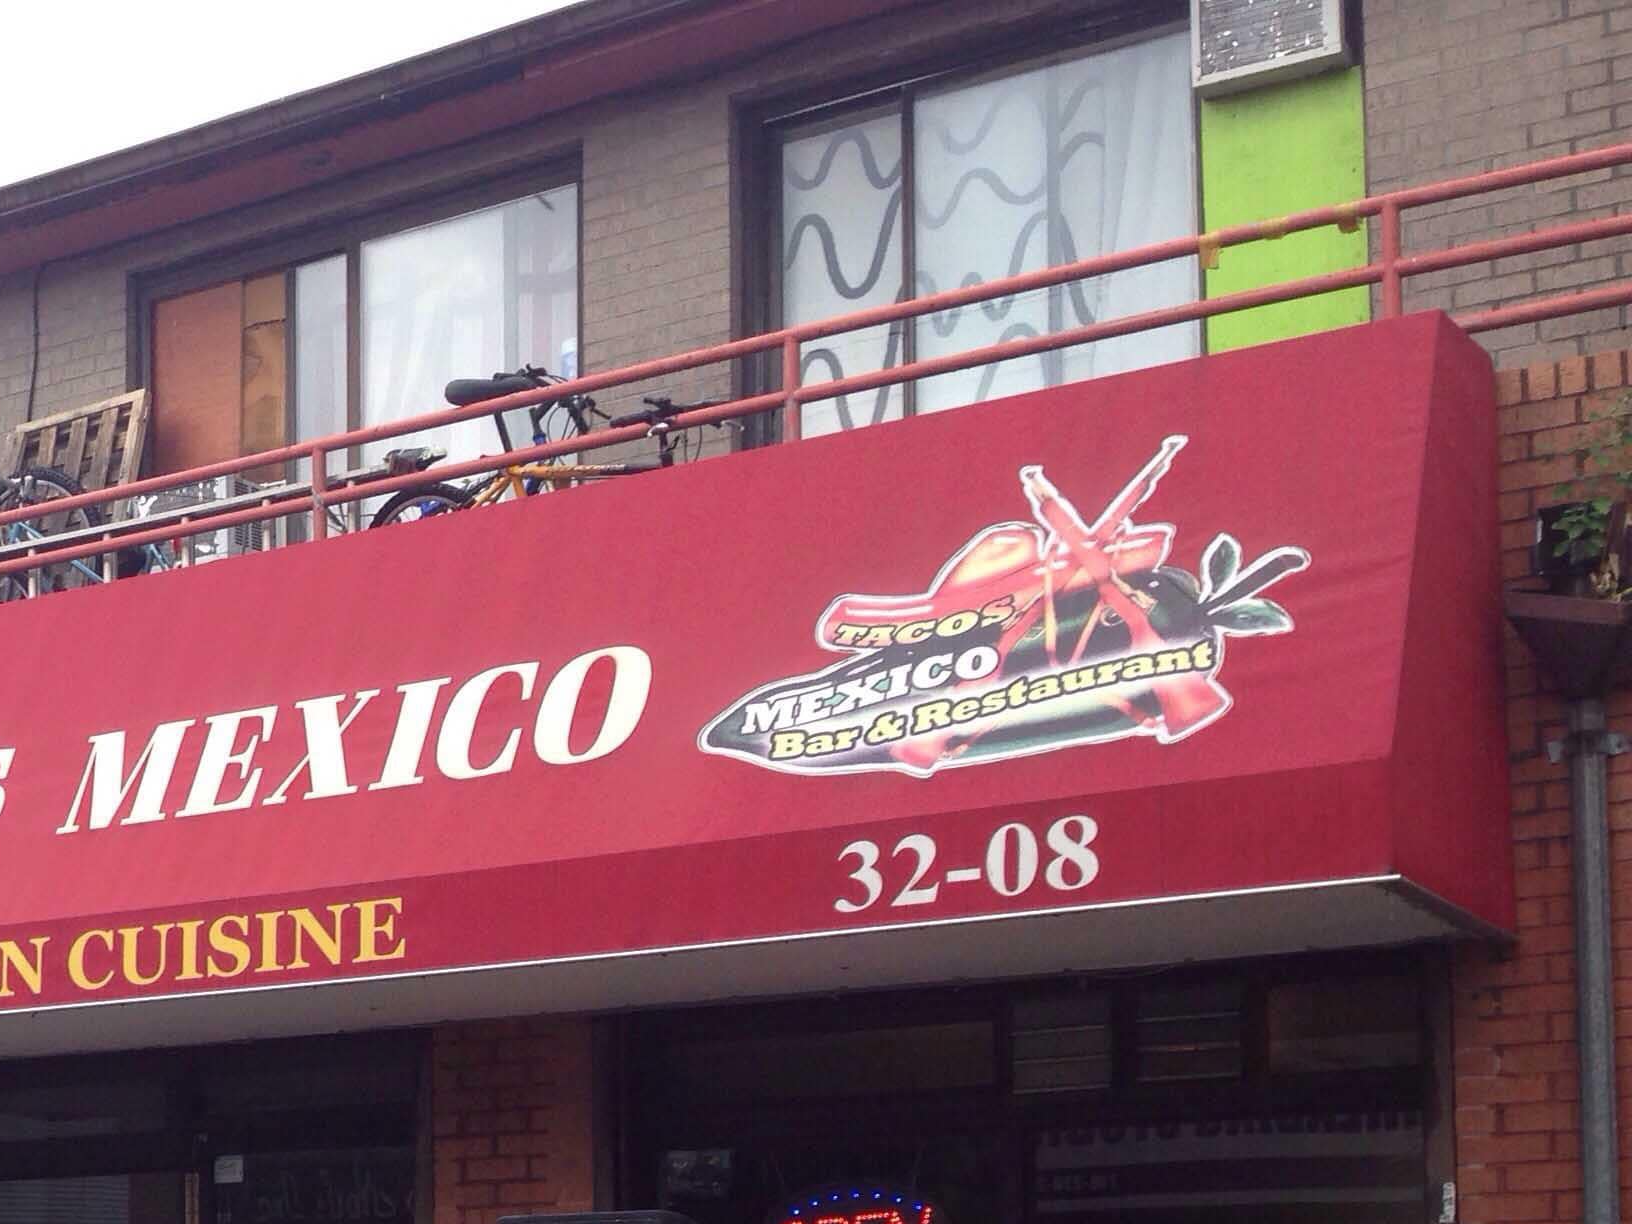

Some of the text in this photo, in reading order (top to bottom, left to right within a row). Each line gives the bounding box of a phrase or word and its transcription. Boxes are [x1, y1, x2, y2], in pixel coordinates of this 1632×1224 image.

[832, 594, 1016, 648] TACOS
[739, 645, 1000, 736] MEXICO
[768, 640, 1217, 761] Bar & Restaurant
[57, 644, 654, 835] MEXICO
[833, 814, 1101, 914] 32-08
[67, 897, 407, 989] CUISINE
